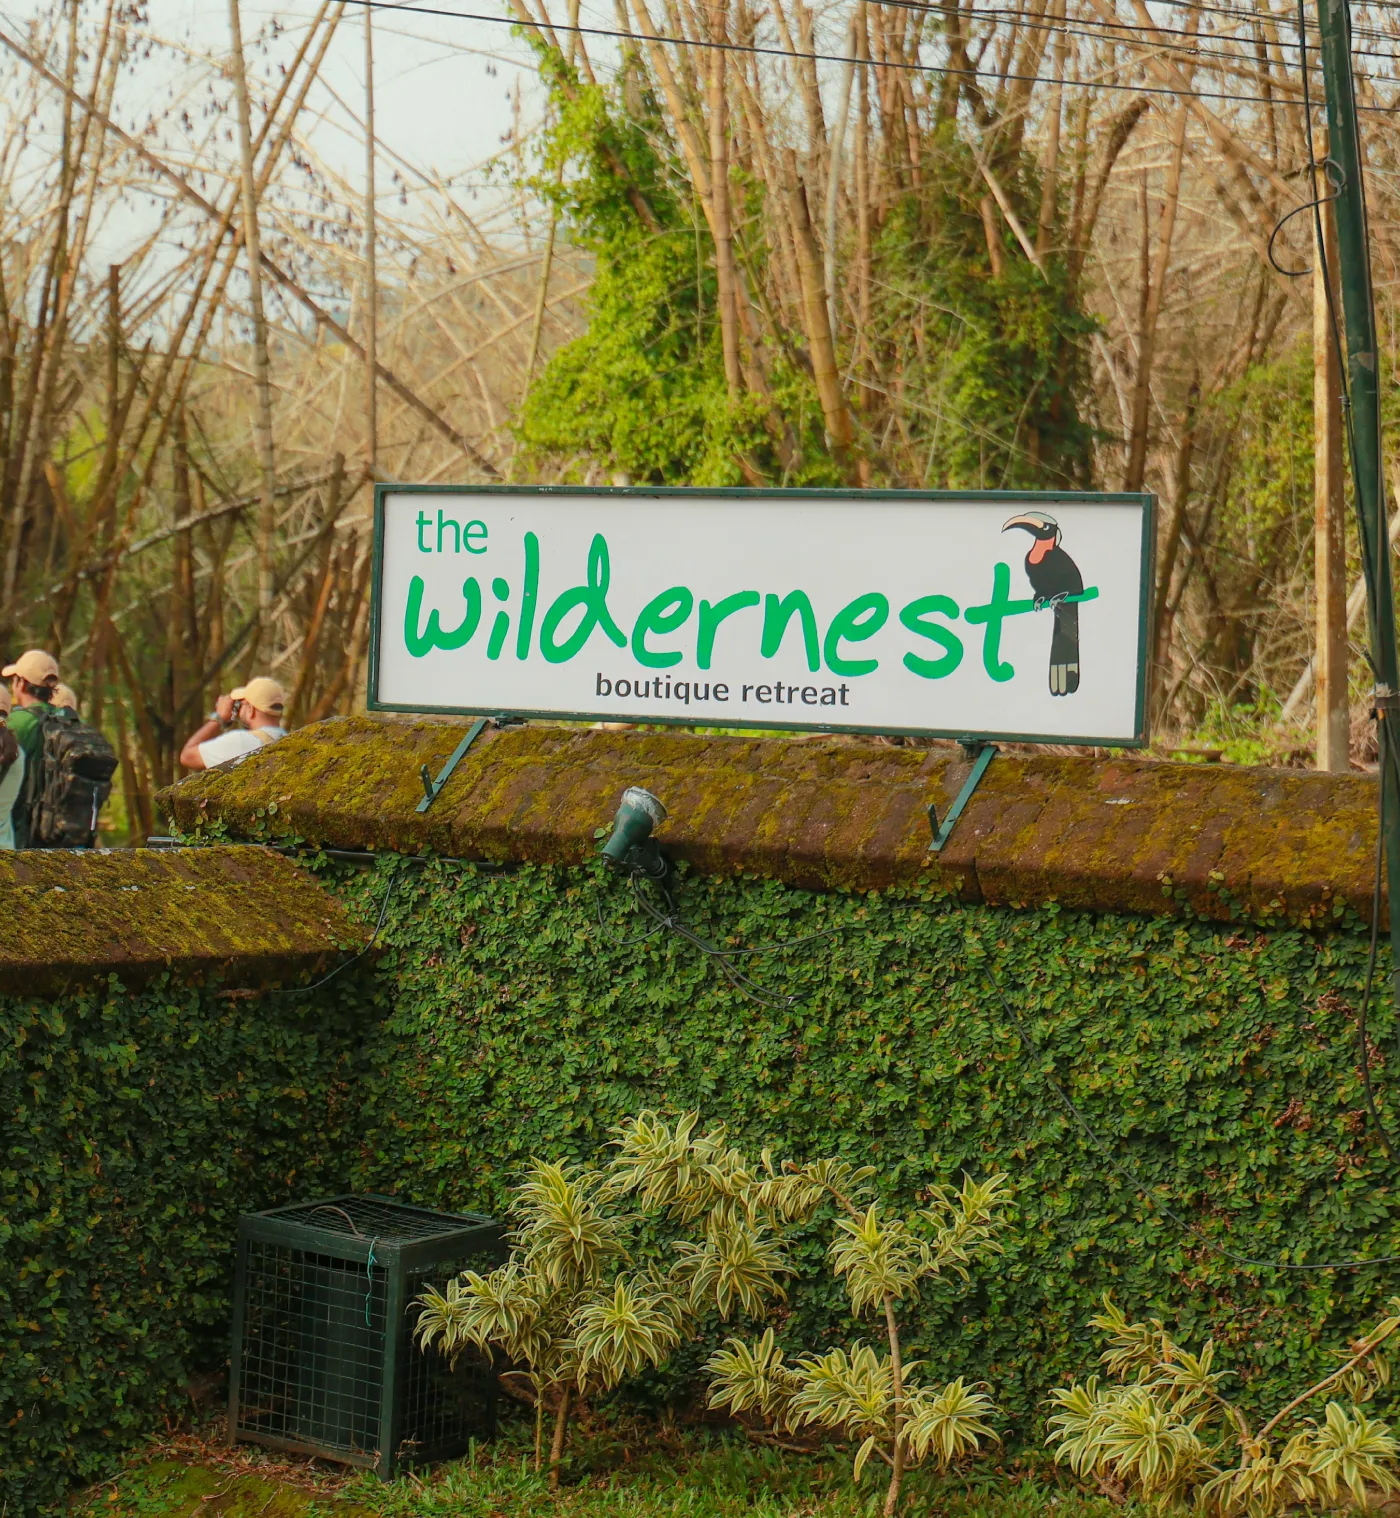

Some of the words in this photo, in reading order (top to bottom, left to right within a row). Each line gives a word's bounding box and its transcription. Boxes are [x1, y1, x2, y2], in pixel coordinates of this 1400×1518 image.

[415, 509, 489, 556] the
[403, 531, 1099, 684] wildernest
[595, 672, 729, 705] boutique
[742, 681, 850, 706] retreat
